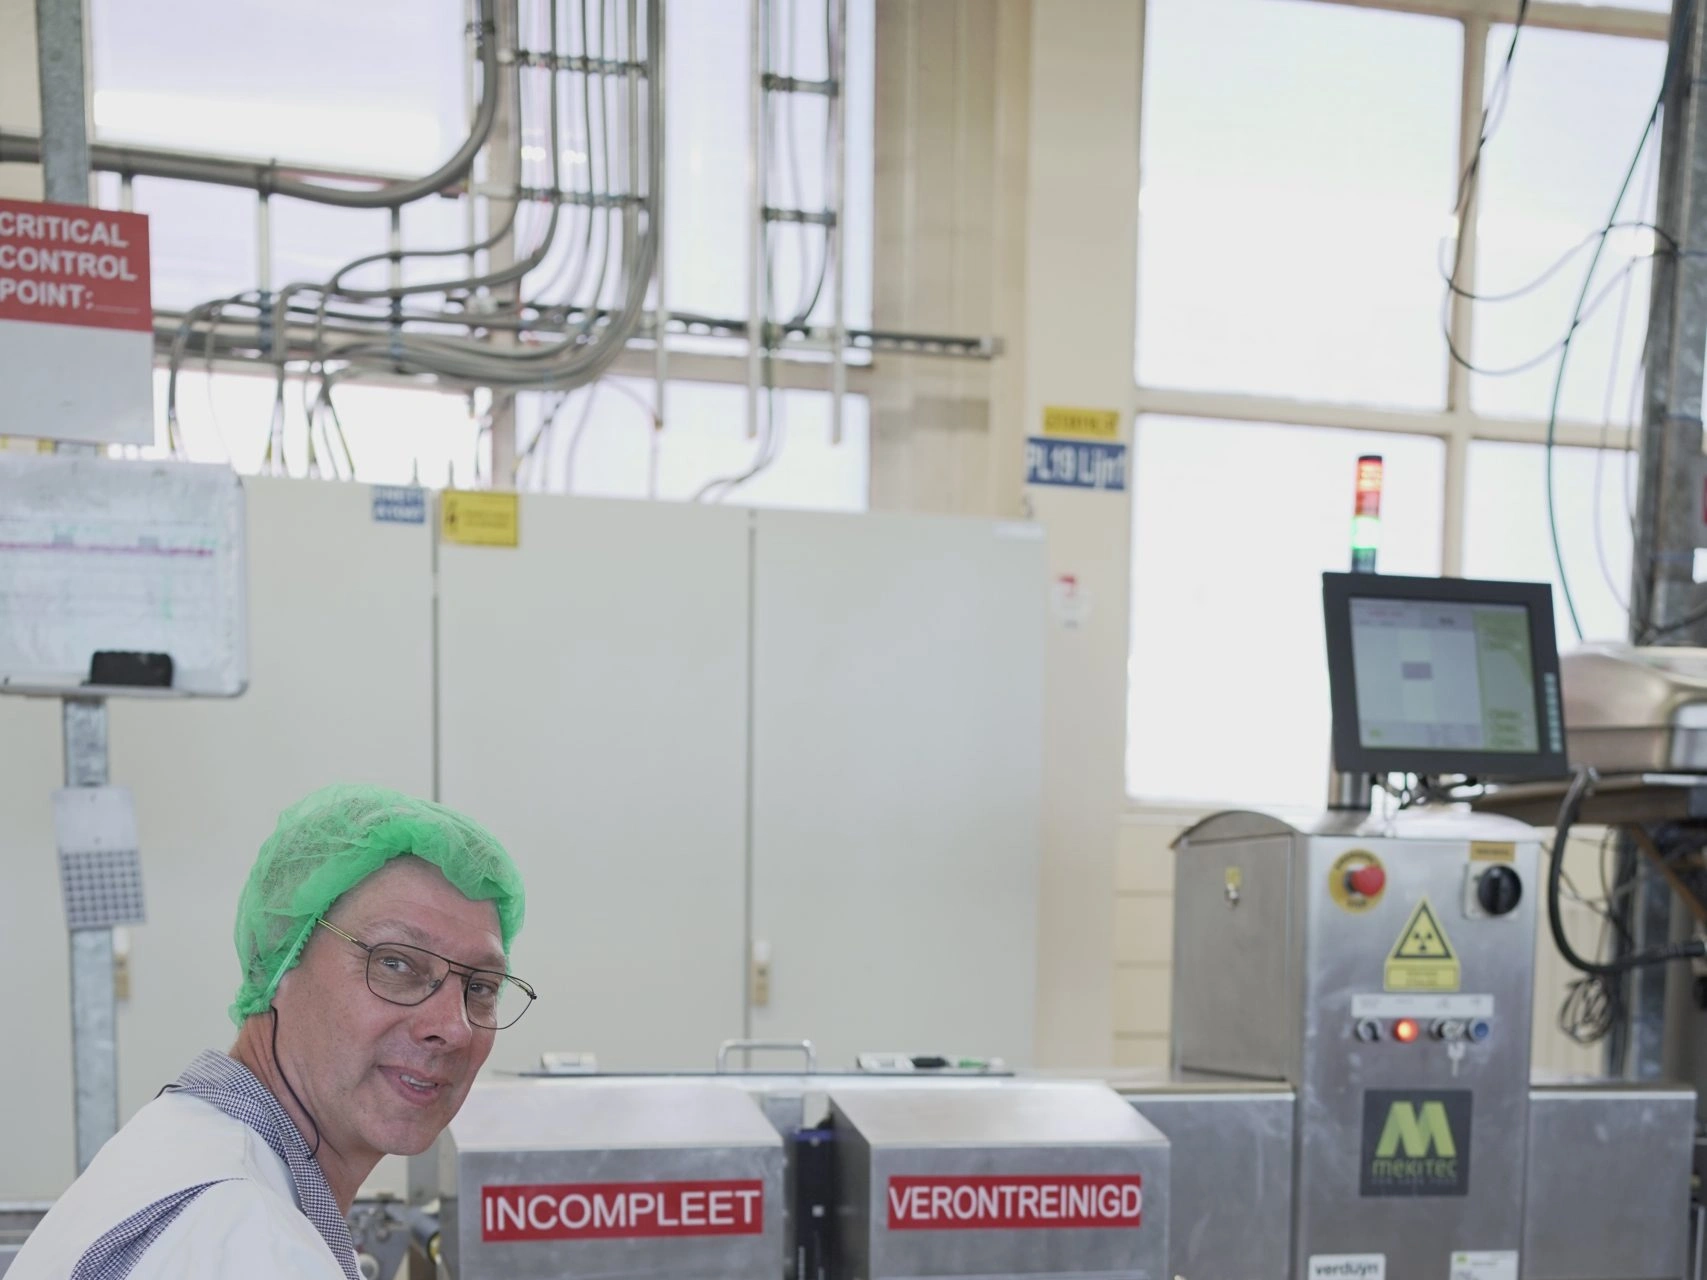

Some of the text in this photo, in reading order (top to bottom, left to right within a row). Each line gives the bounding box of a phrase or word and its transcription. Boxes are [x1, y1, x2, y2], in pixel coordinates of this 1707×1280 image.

[0, 211, 129, 248] CRITICAL
[0, 245, 137, 282] CONTROL
[0, 278, 95, 311] POINT:
[486, 1190, 761, 1232] INCOMPLEET
[889, 1184, 1143, 1220] VERONTREINIGD
